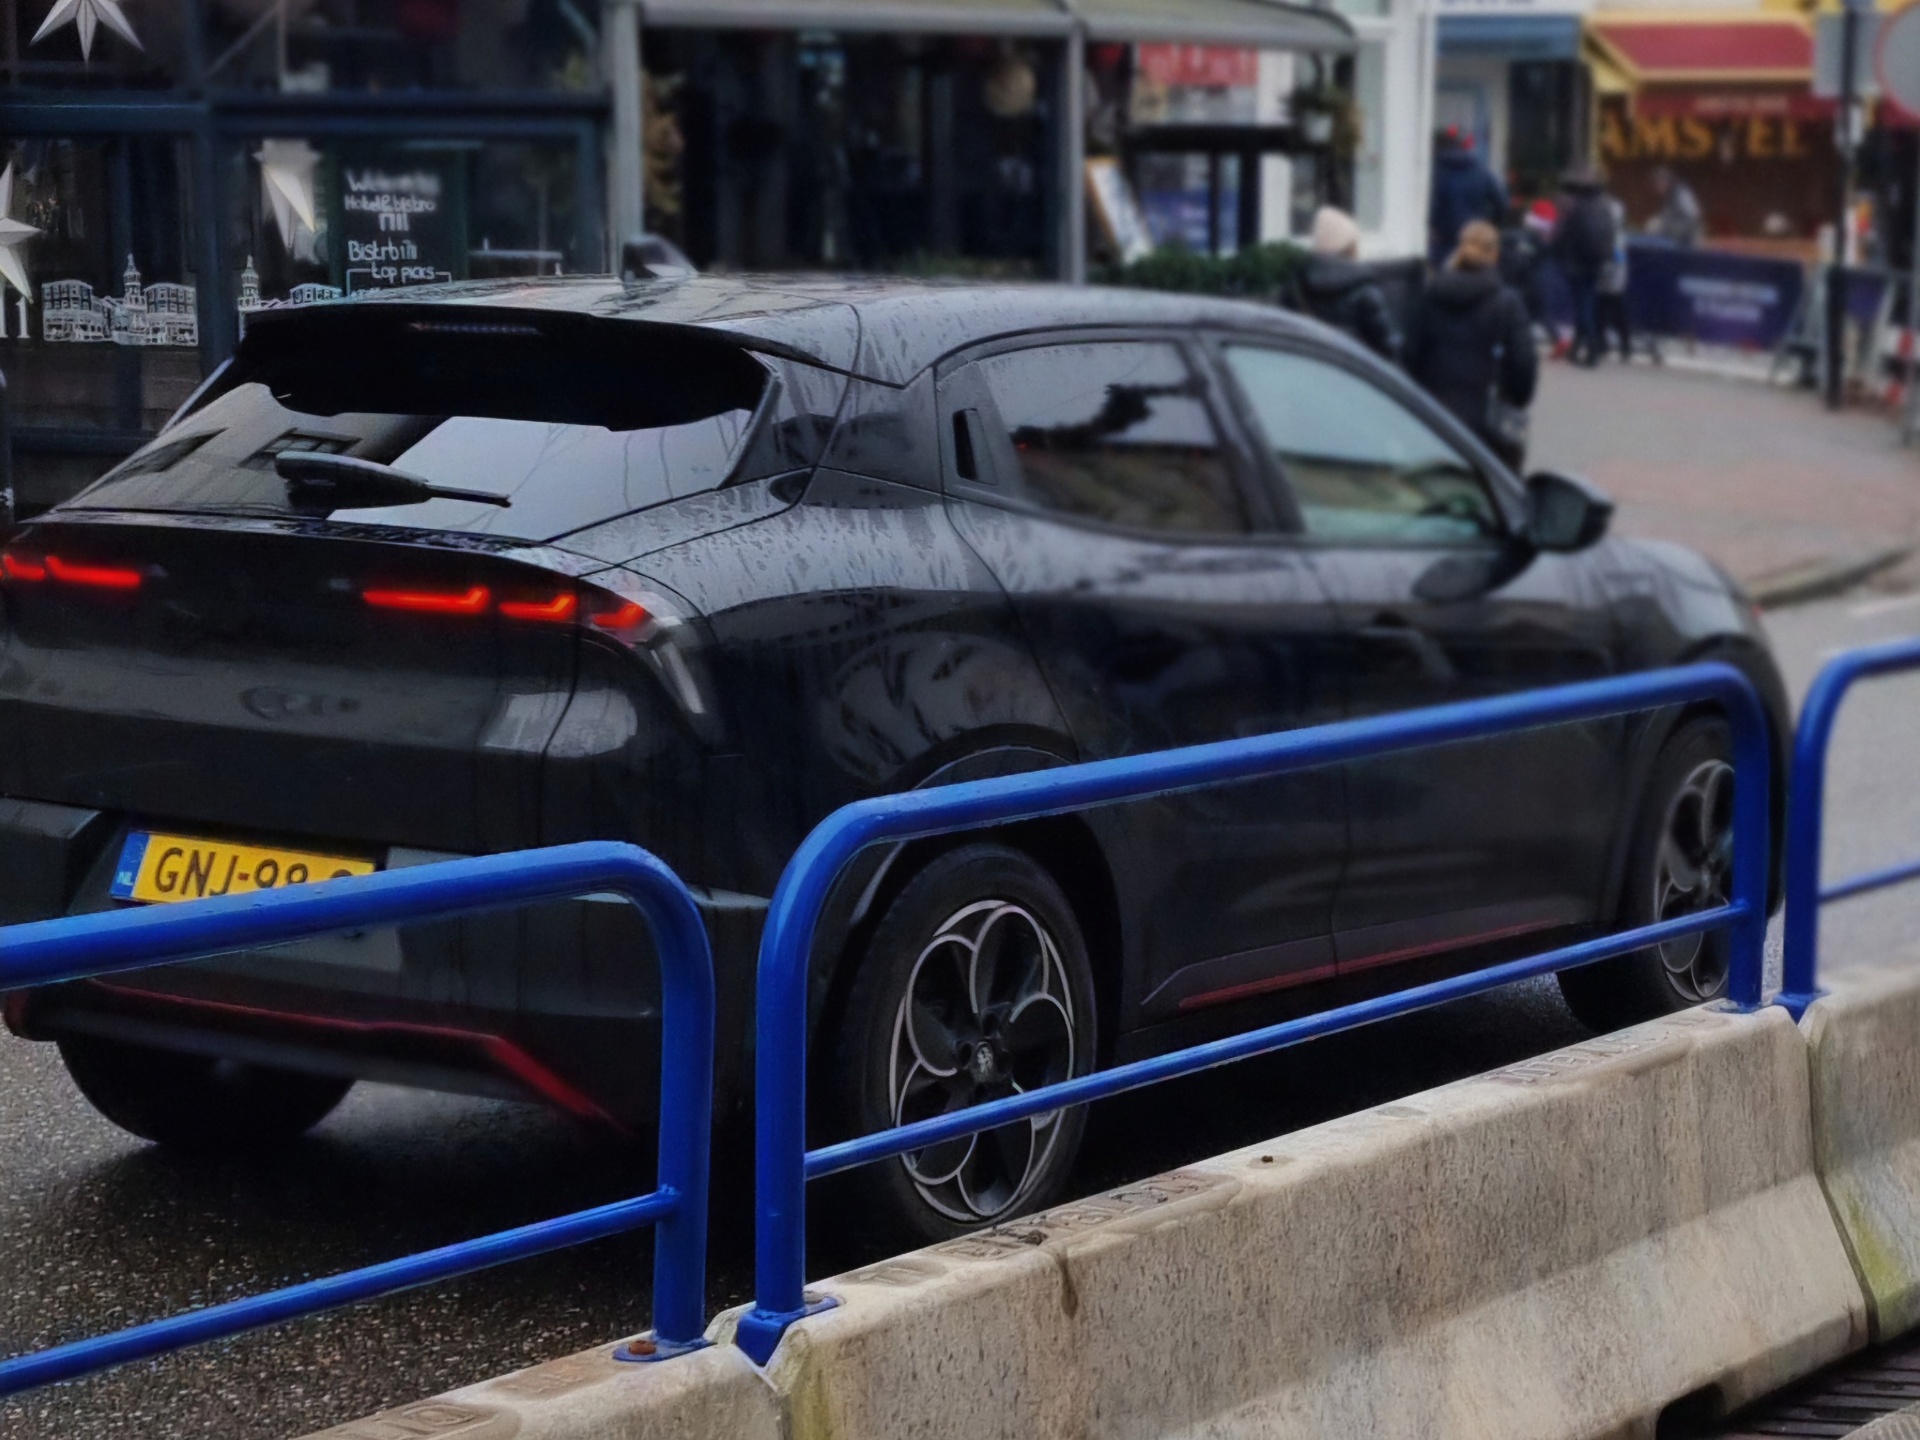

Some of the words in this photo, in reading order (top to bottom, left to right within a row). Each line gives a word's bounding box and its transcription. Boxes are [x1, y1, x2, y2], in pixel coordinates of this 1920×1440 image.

[1600, 110, 1811, 159] AMSEL
[371, 261, 398, 284] top
[154, 847, 353, 897] GNJ-98
